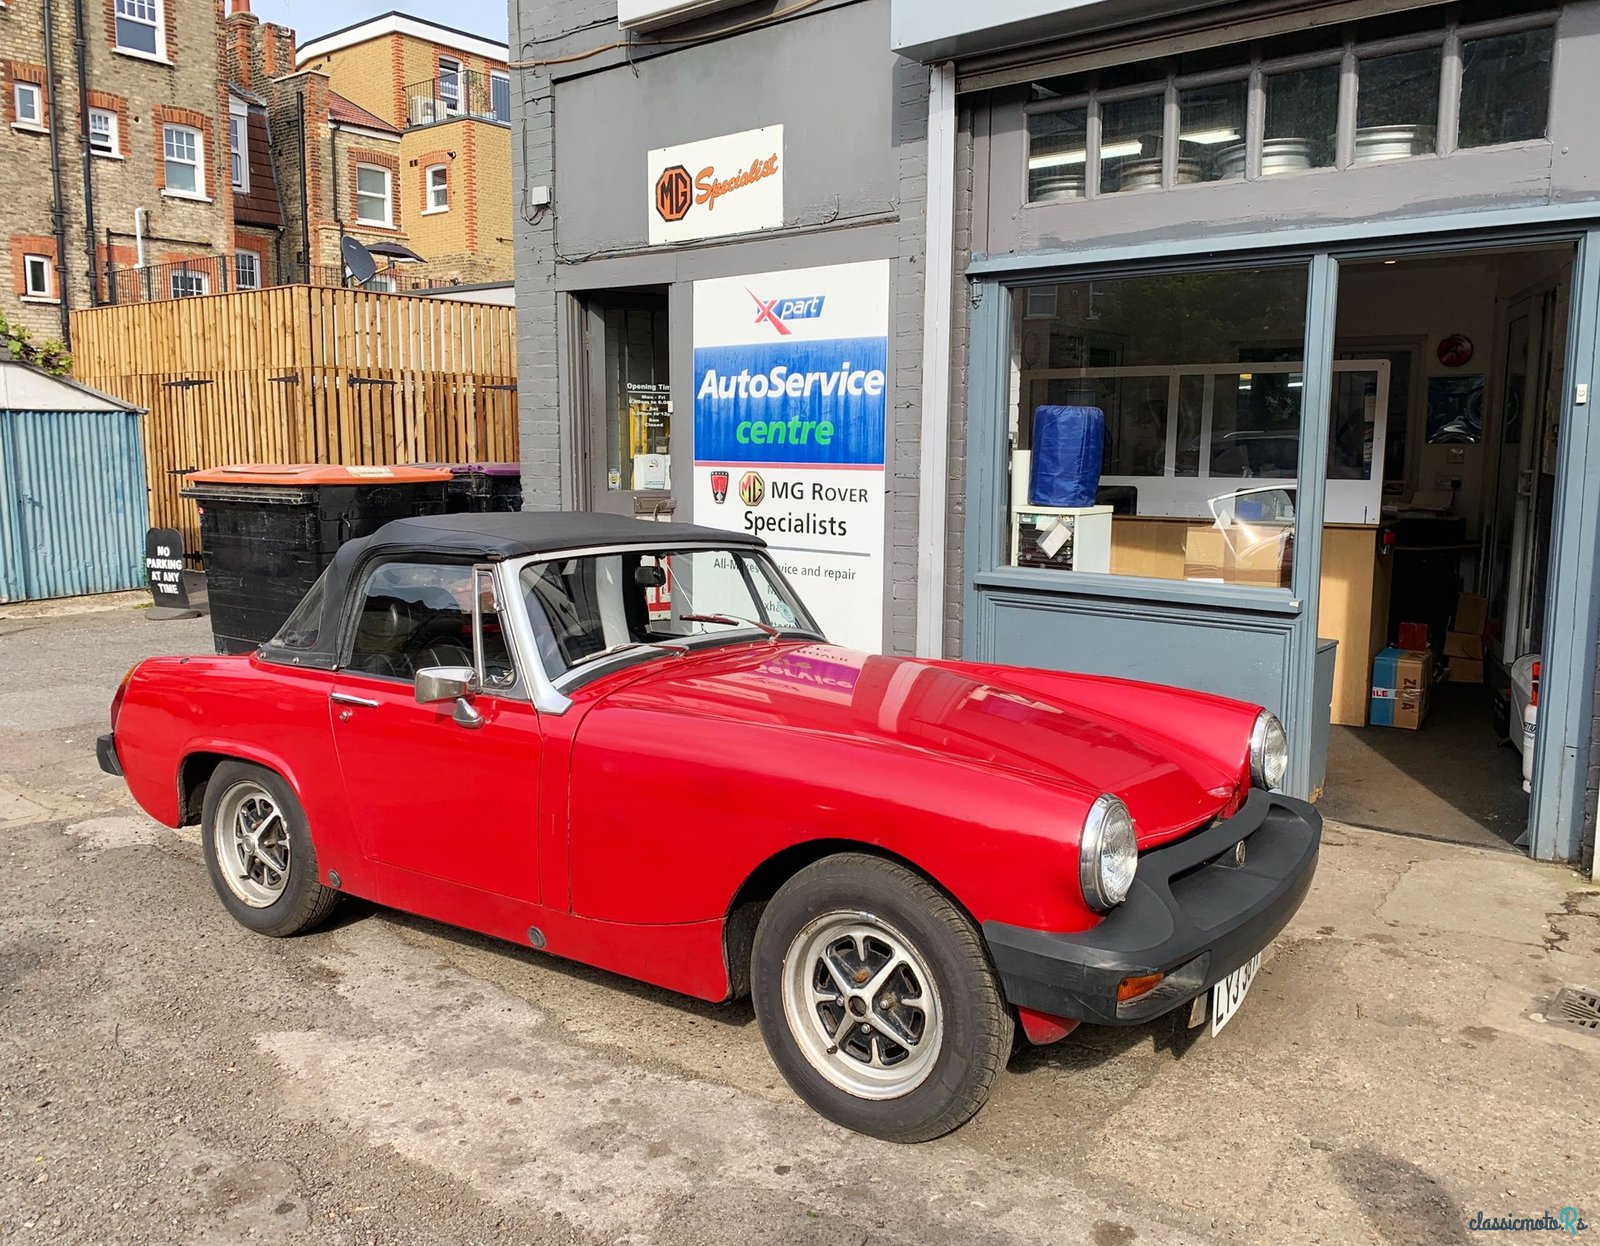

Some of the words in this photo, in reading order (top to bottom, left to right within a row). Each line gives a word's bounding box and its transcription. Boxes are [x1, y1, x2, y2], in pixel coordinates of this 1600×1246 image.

[659, 169, 689, 218] MG
[694, 153, 778, 211] Specialist
[627, 382, 656, 391] Opening
[696, 362, 885, 399] AutoService
[736, 416, 834, 445] centre
[741, 473, 763, 504] MG
[771, 482, 804, 499] MG
[744, 511, 847, 536] Specialists
[157, 546, 171, 557] NO
[146, 558, 182, 570] PARKING
[151, 571, 161, 581] AT
[163, 571, 180, 582] ANY
[801, 566, 821, 577] and
[824, 569, 857, 581] repair
[157, 583, 179, 594] TIME
